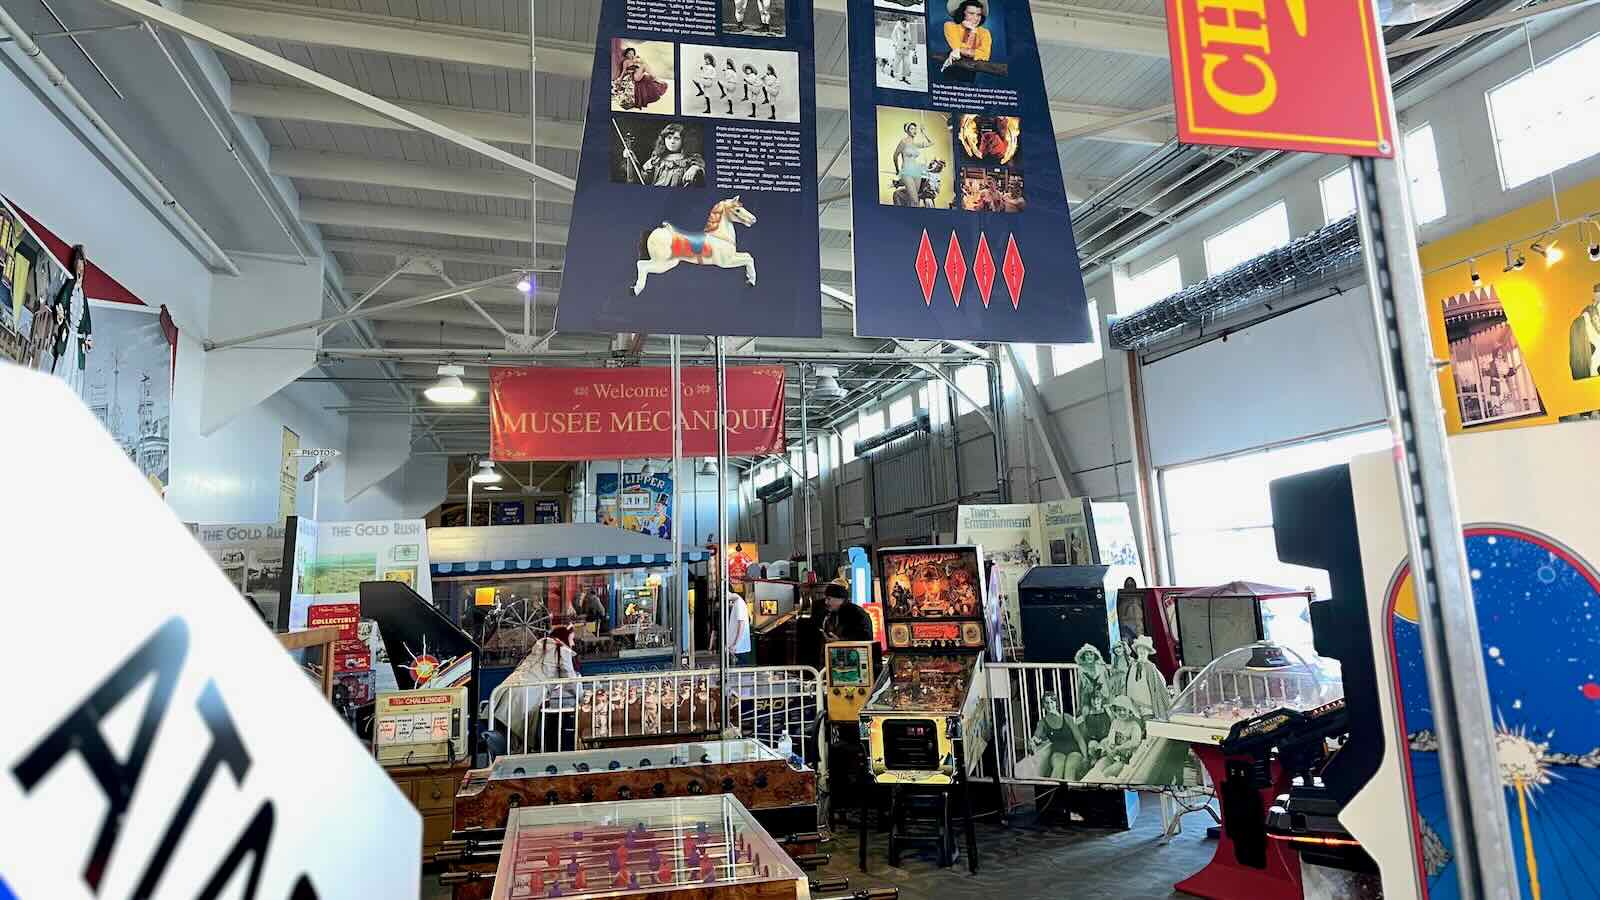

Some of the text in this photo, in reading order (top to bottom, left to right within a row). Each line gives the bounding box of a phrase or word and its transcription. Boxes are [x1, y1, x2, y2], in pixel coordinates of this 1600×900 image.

[593, 382, 669, 399] Welcome
[502, 404, 602, 434] MUSÉE
[302, 448, 336, 457] PHOTOS
[624, 473, 665, 489] LIPPER
[203, 529, 224, 542] THE
[226, 527, 262, 541] GOLD
[265, 525, 286, 539] RUS
[331, 526, 352, 537] THE
[355, 523, 389, 537] GOLD
[311, 616, 357, 626] COLLECTIBLE
[405, 695, 449, 706] CHALLENGER
